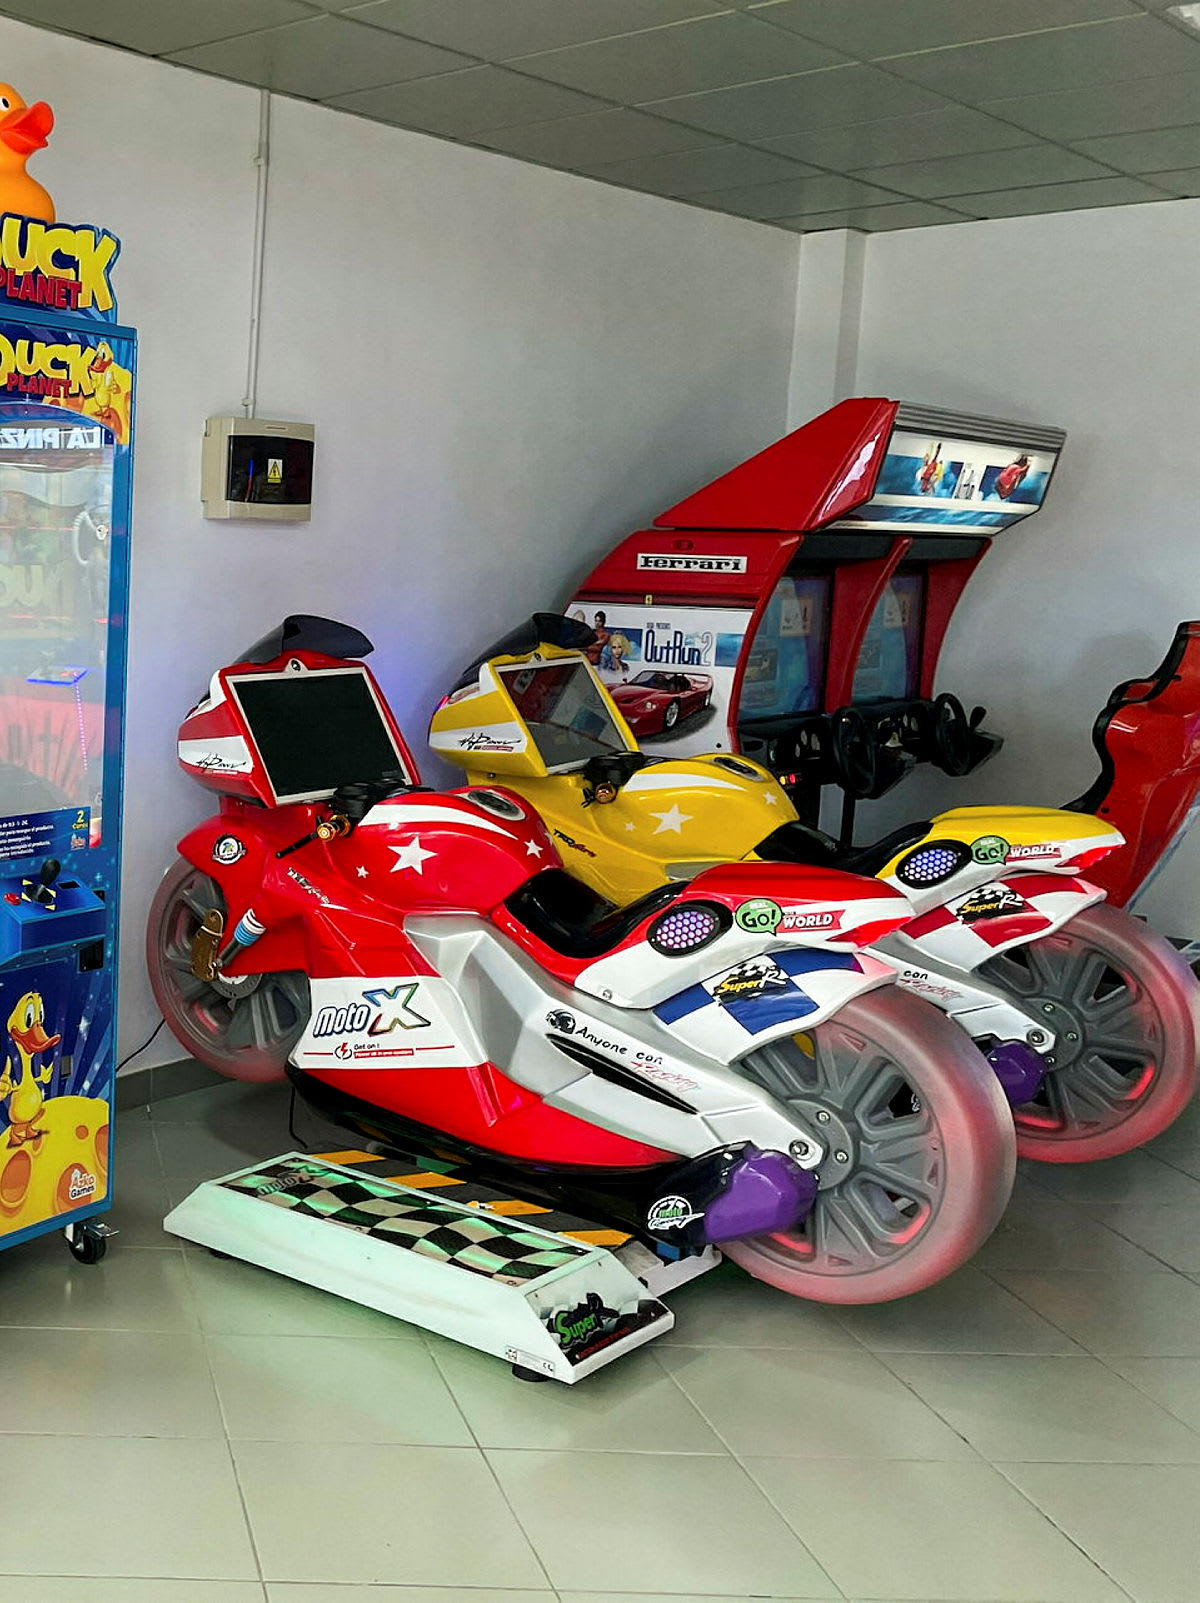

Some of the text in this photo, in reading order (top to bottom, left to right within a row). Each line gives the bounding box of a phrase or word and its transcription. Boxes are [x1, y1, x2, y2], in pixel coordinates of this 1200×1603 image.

[7, 373, 72, 397] PLANET
[640, 555, 741, 570] Ferrari
[76, 810, 85, 823] 2
[1010, 845, 1055, 857] WORLD
[784, 913, 834, 930] WORLD
[574, 1026, 629, 1056] Anyone
[555, 1312, 597, 1344] Super
